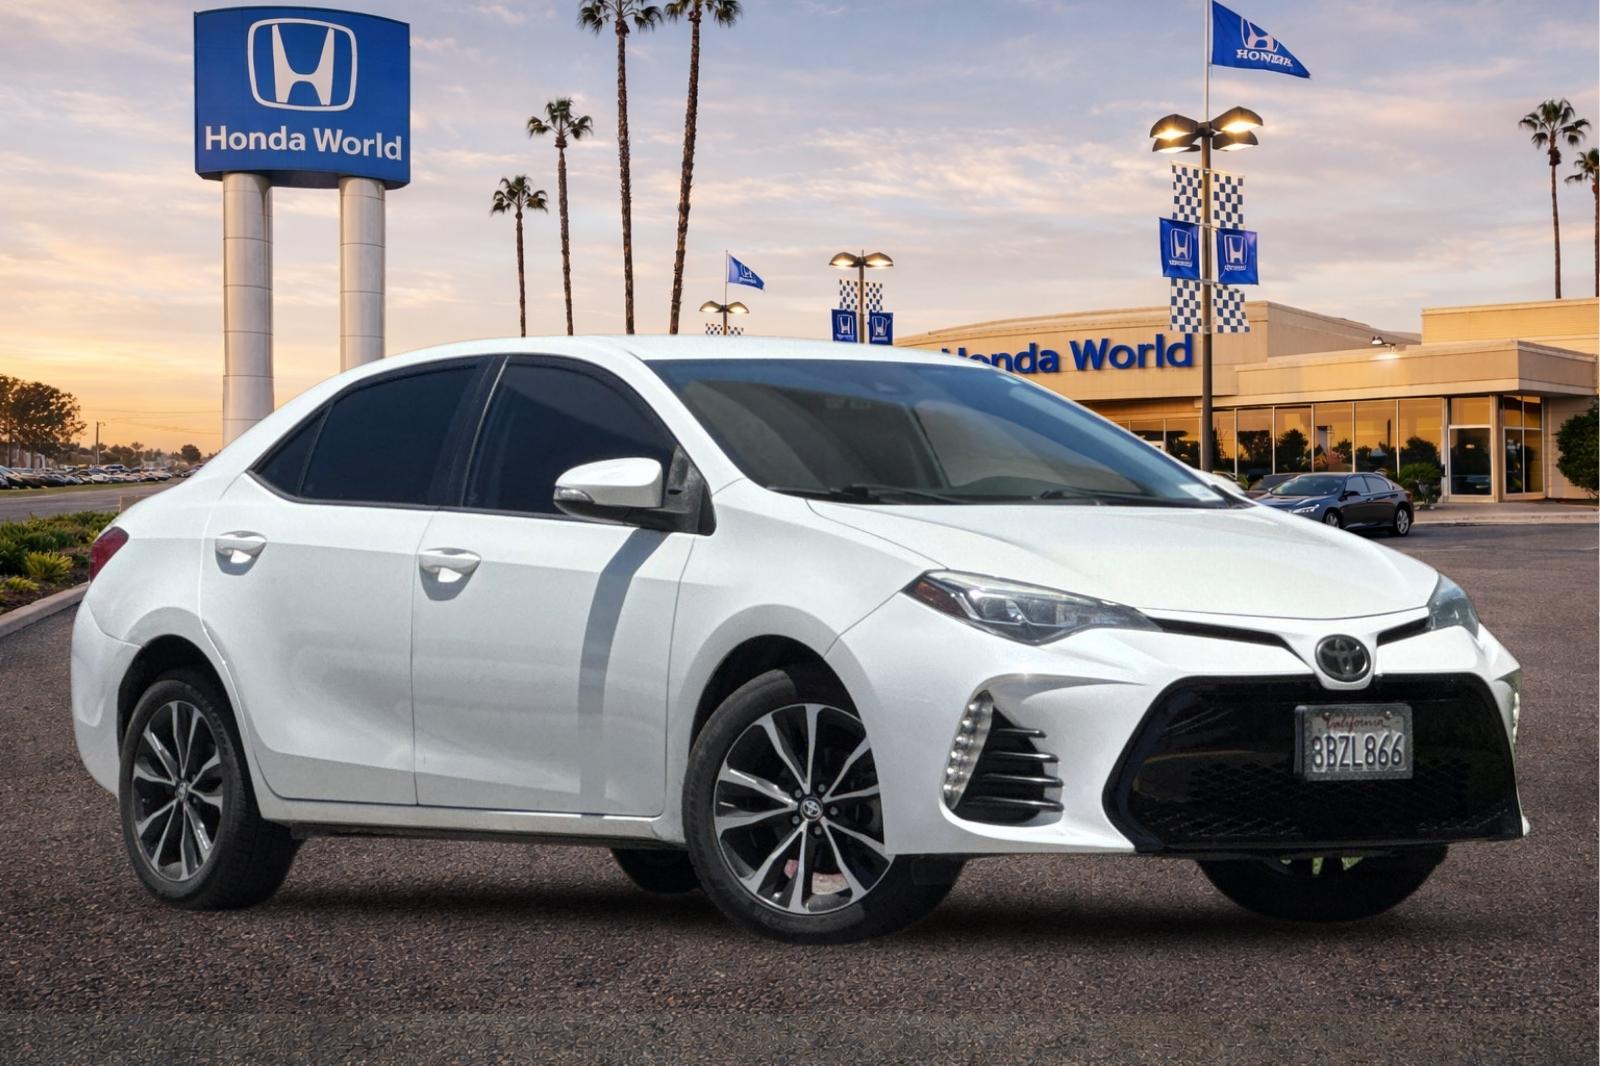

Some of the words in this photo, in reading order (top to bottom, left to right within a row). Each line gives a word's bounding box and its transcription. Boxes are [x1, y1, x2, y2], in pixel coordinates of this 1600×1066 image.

[205, 125, 306, 151] Honda
[313, 127, 402, 160] World
[941, 342, 1060, 374] nda
[1069, 333, 1193, 371] World
[1312, 733, 1404, 768] 8BZL866
